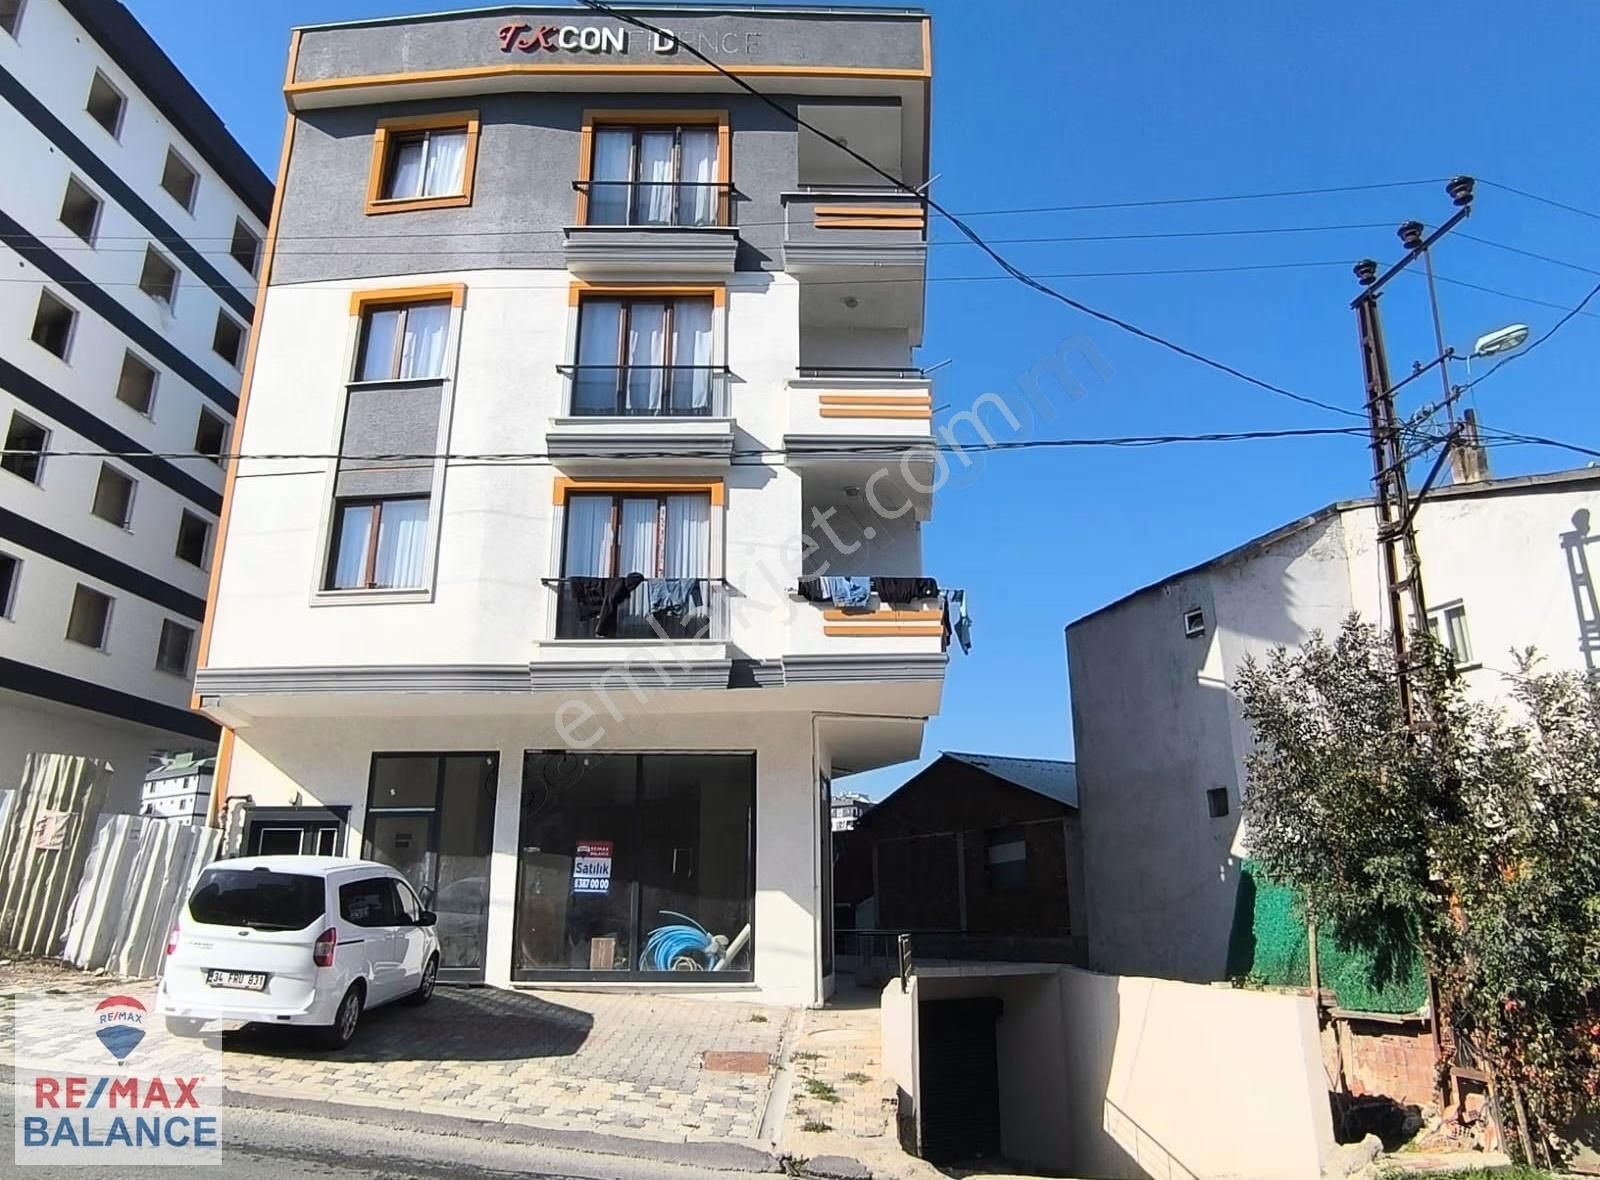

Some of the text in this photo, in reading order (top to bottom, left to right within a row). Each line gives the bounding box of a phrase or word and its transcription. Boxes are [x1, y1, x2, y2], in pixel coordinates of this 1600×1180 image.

[576, 862, 609, 875] Satılık
[590, 878, 599, 889] 00
[600, 878, 609, 889] 00
